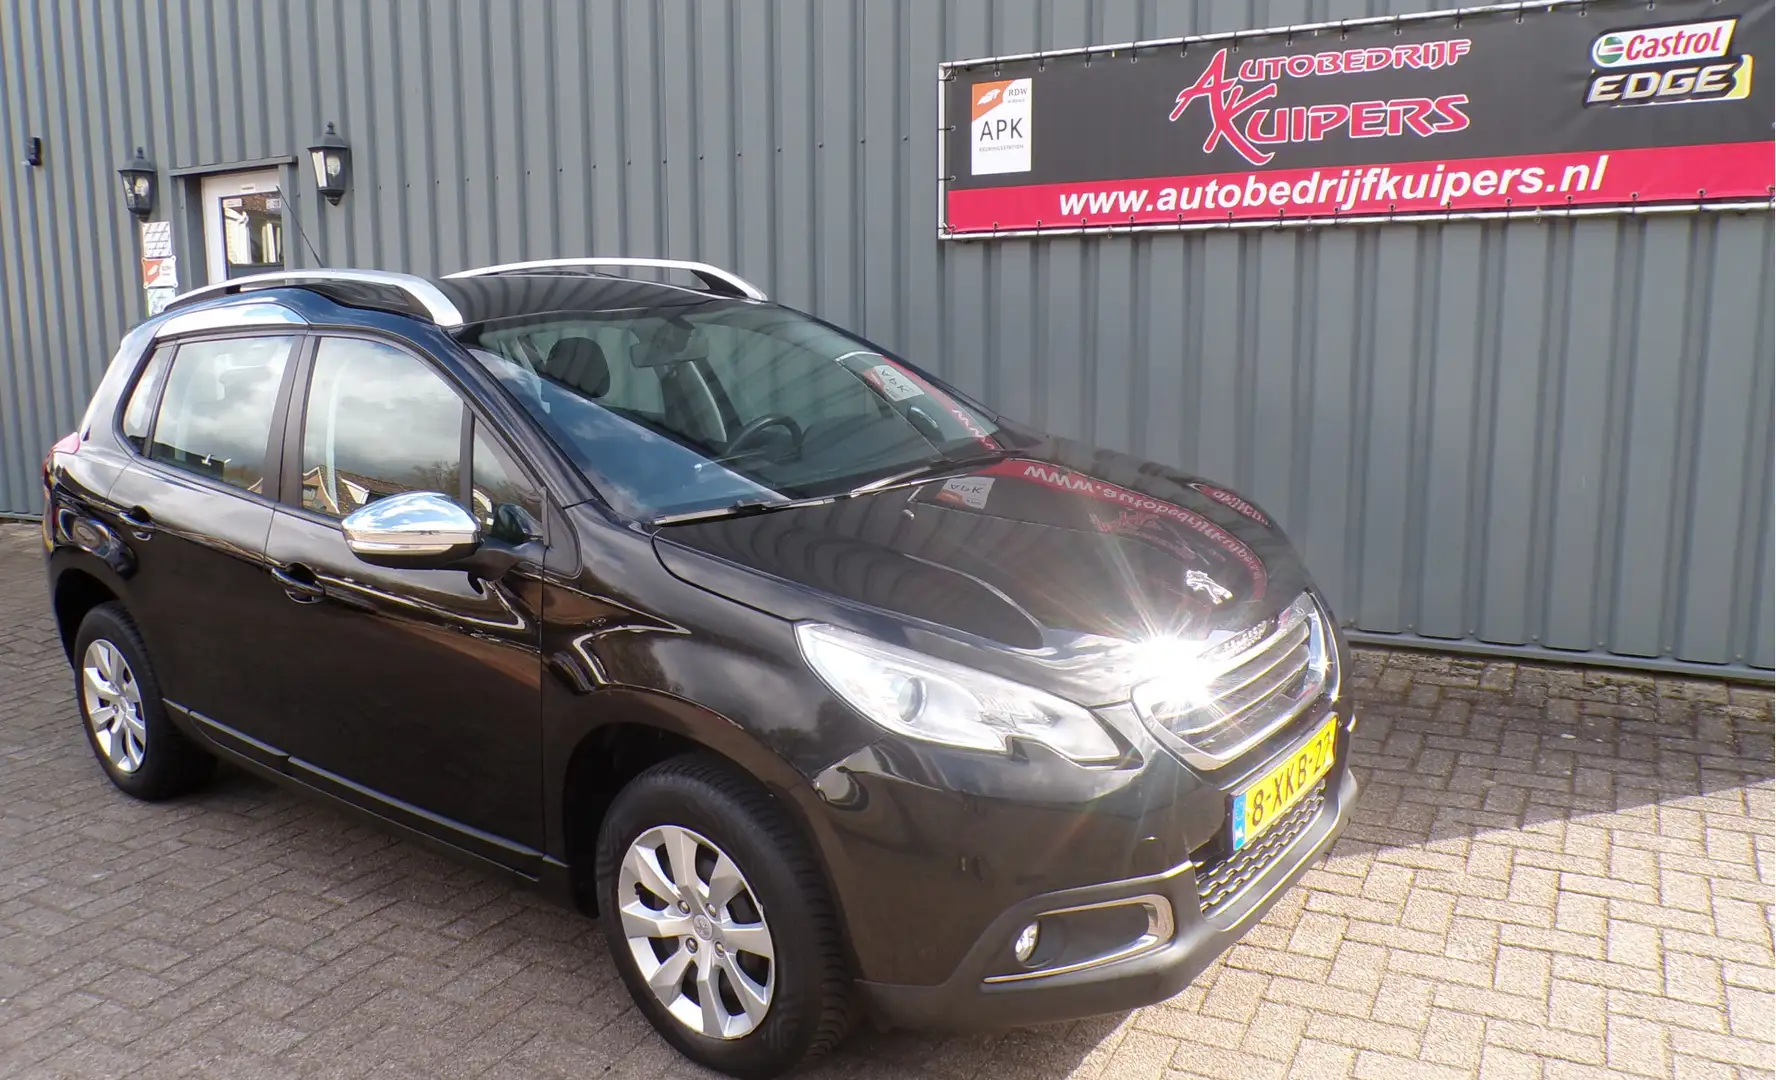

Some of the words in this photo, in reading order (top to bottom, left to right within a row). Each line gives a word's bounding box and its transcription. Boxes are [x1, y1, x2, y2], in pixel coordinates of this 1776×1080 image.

[1626, 26, 1723, 60] Castrol
[1008, 88, 1028, 97] RDW
[1587, 63, 1738, 103] EDGE
[980, 118, 1023, 141] APK
[1059, 155, 1610, 215] www.autobedrijfkuipers.nl
